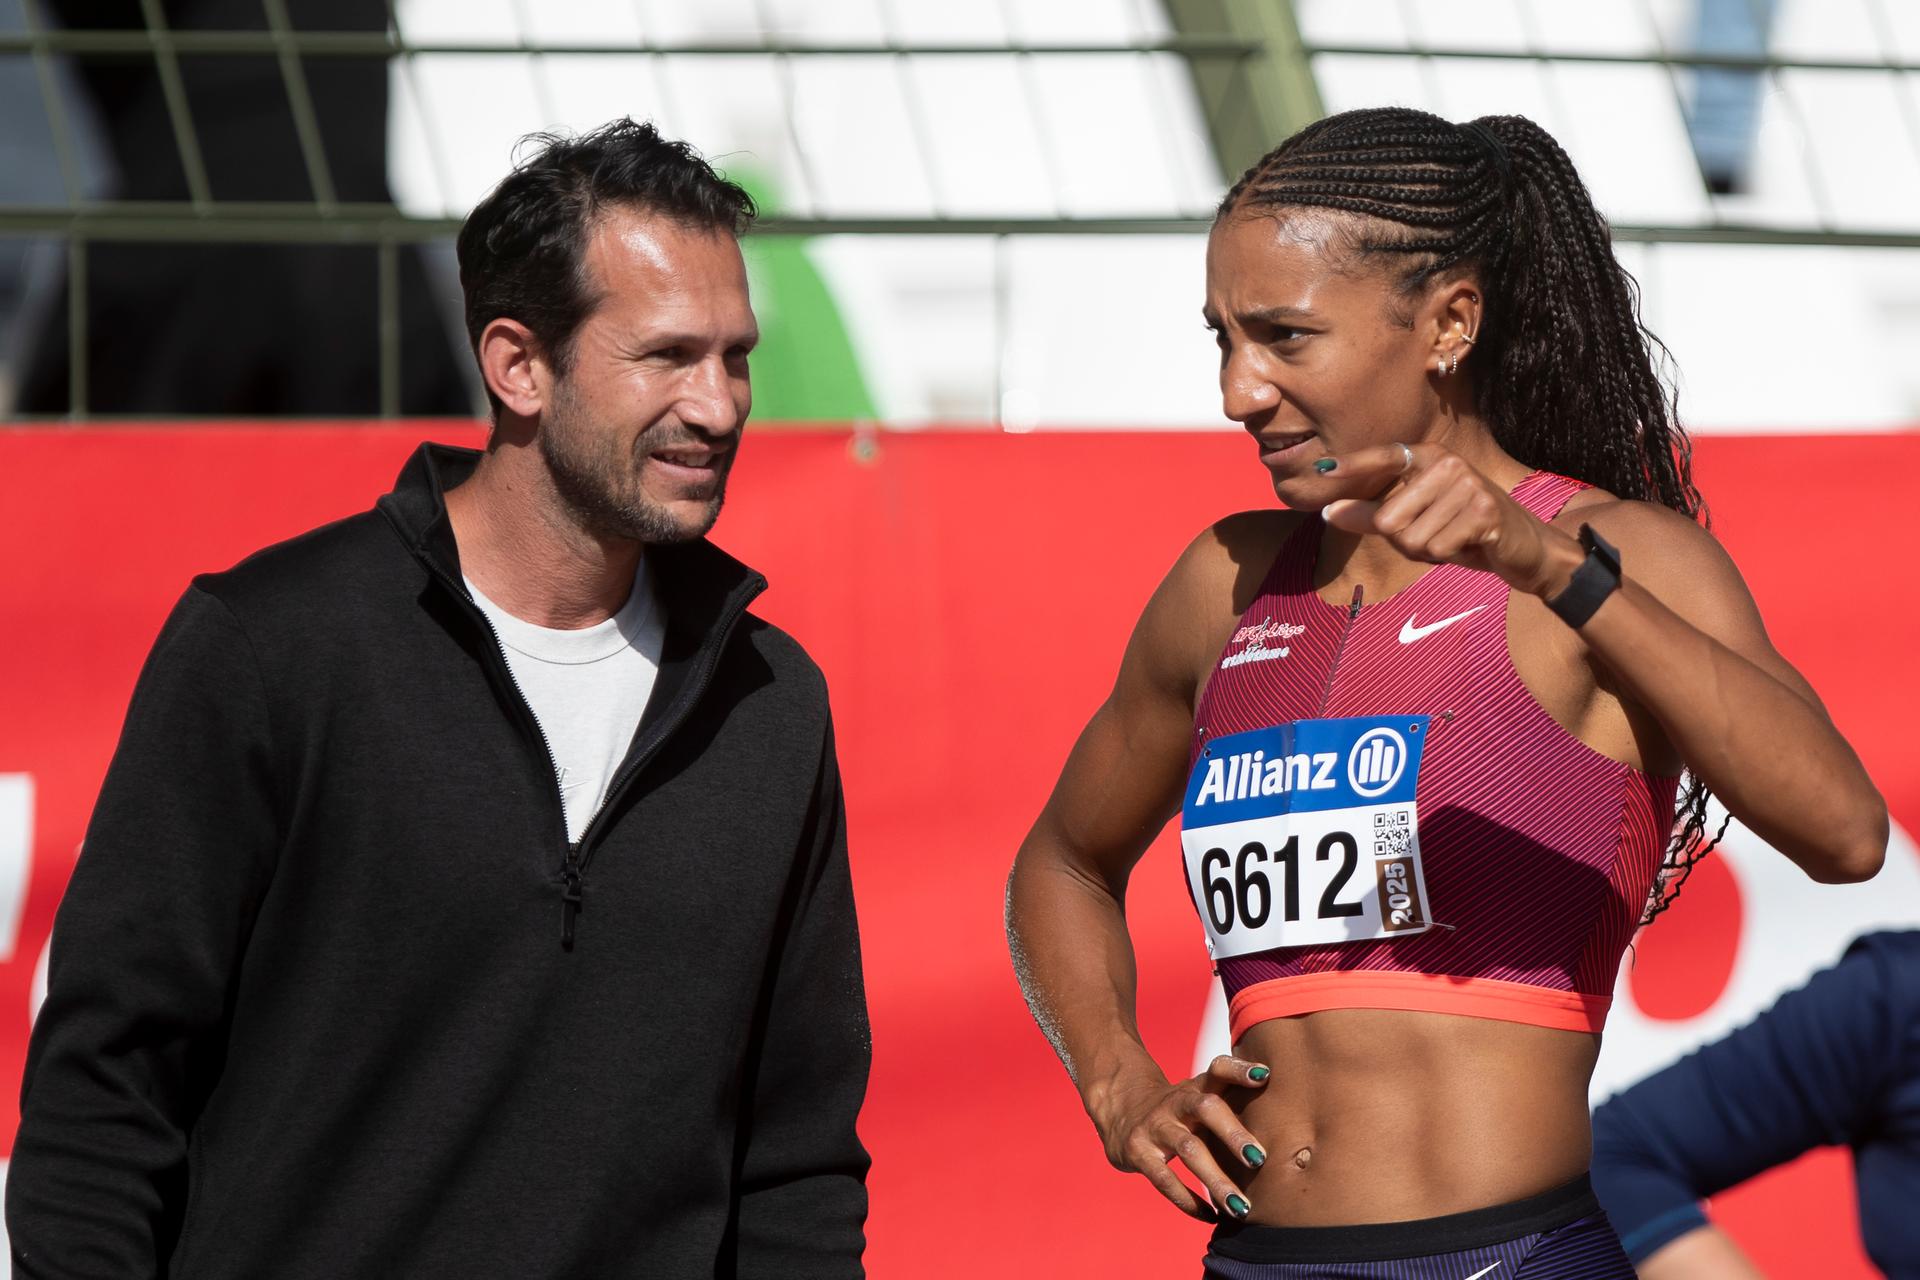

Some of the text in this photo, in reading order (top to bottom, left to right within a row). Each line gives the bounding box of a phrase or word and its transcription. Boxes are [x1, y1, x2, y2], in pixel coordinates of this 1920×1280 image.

[1195, 750, 1338, 806] Allianz
[1201, 831, 1364, 935] 6612
[1384, 862, 1413, 925] 2025
